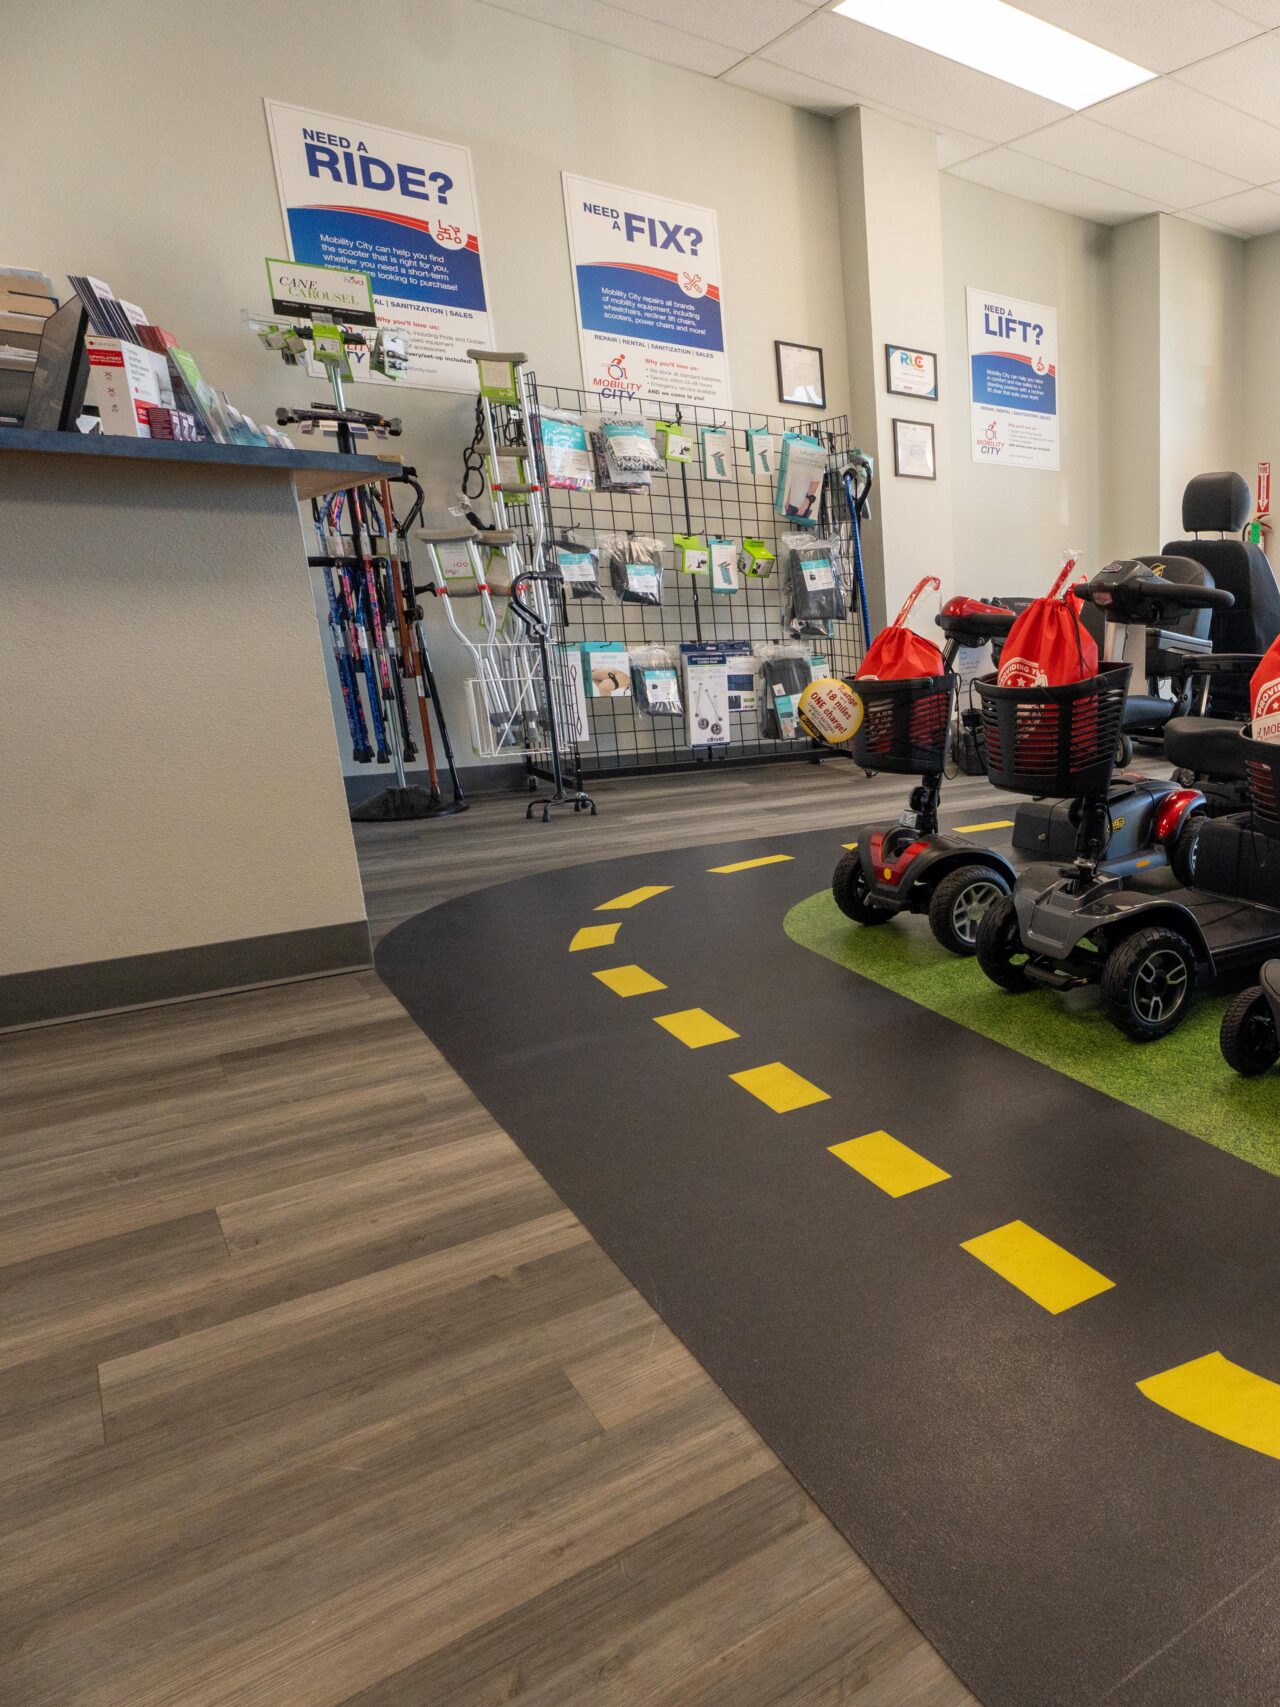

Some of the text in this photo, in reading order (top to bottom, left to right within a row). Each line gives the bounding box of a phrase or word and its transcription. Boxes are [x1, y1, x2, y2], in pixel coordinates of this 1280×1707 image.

[303, 128, 368, 153] NEED A
[304, 142, 453, 205] RIDE?
[583, 202, 619, 219] NEED
[612, 221, 621, 231] A
[624, 212, 703, 257] FIX?
[320, 234, 354, 248] Mobility
[356, 241, 373, 251] City
[393, 248, 411, 258] help
[413, 252, 427, 260] you
[429, 254, 445, 263] find
[321, 244, 449, 273] the scooter that is right for you,
[323, 254, 357, 265] whether
[360, 260, 375, 269] you
[378, 264, 398, 273] need
[408, 268, 449, 280] short-term
[279, 276, 317, 290] CANE
[378, 272, 408, 284] looking
[420, 279, 458, 291] purchase!
[289, 287, 359, 305] CAROUSEL
[601, 287, 627, 298] Mobility
[628, 292, 641, 300] City
[643, 296, 664, 305] repairs
[674, 302, 695, 311] brands
[390, 301, 444, 314] SANITIZATION
[449, 311, 473, 319] SALES
[603, 304, 643, 317] wheelchairs,
[644, 312, 666, 321] recliner
[677, 317, 697, 326] chairs,
[610, 297, 636, 308] mobility
[637, 303, 672, 315] equipment,
[673, 309, 700, 320] including
[984, 304, 1013, 317] NEED A
[375, 315, 390, 324] Why
[393, 318, 412, 327] you'll
[413, 321, 427, 329] love
[604, 312, 633, 323] scooters,
[635, 318, 654, 326] power
[656, 321, 675, 330] chairs
[984, 313, 1044, 345] LIFT?
[594, 334, 714, 359] REPAIR RENTAL SANITIZATION SALES
[593, 378, 642, 391] MOBILITY
[600, 388, 635, 401] CITY
[976, 439, 1005, 448] MOBILITY
[981, 446, 1001, 455] CITY
[827, 690, 852, 720] 18 miles
[838, 684, 858, 708] Range
[810, 692, 848, 734] ONE charge!
